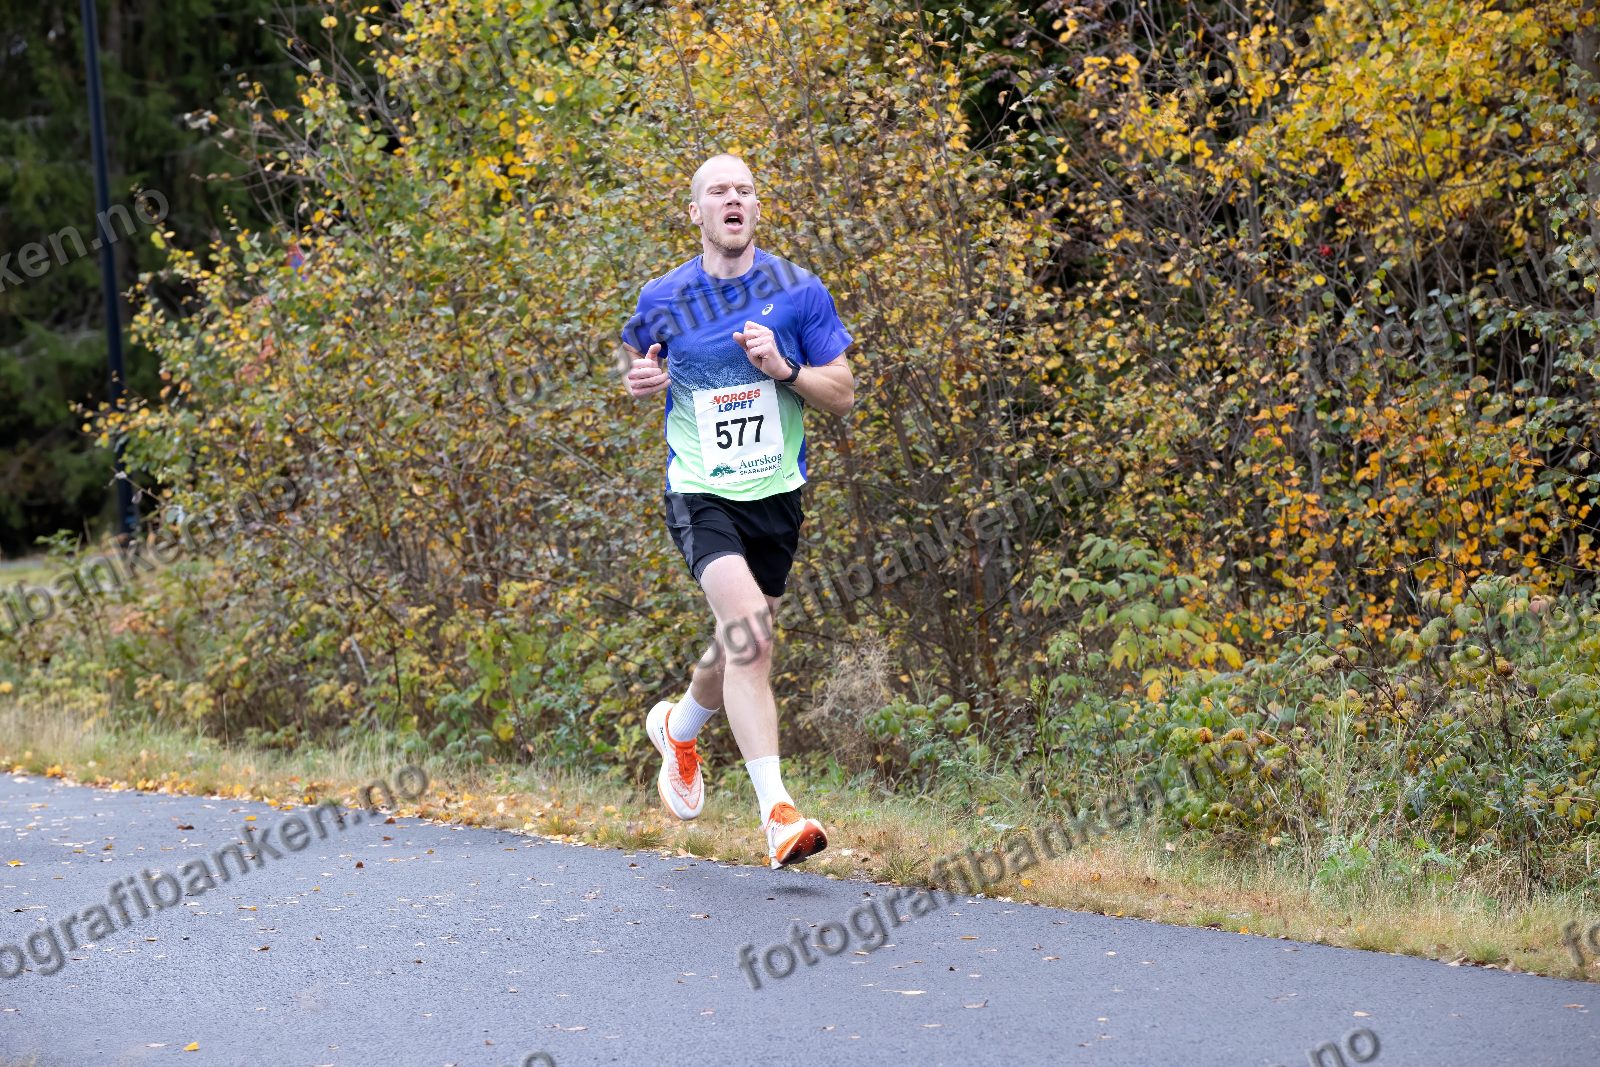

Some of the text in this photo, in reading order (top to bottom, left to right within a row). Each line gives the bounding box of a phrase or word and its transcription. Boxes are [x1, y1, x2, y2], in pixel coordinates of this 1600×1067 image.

[713, 389, 761, 404] NORGES
[718, 399, 754, 412] LØPET
[716, 415, 764, 449] 577
[739, 454, 782, 469] Aurskog
